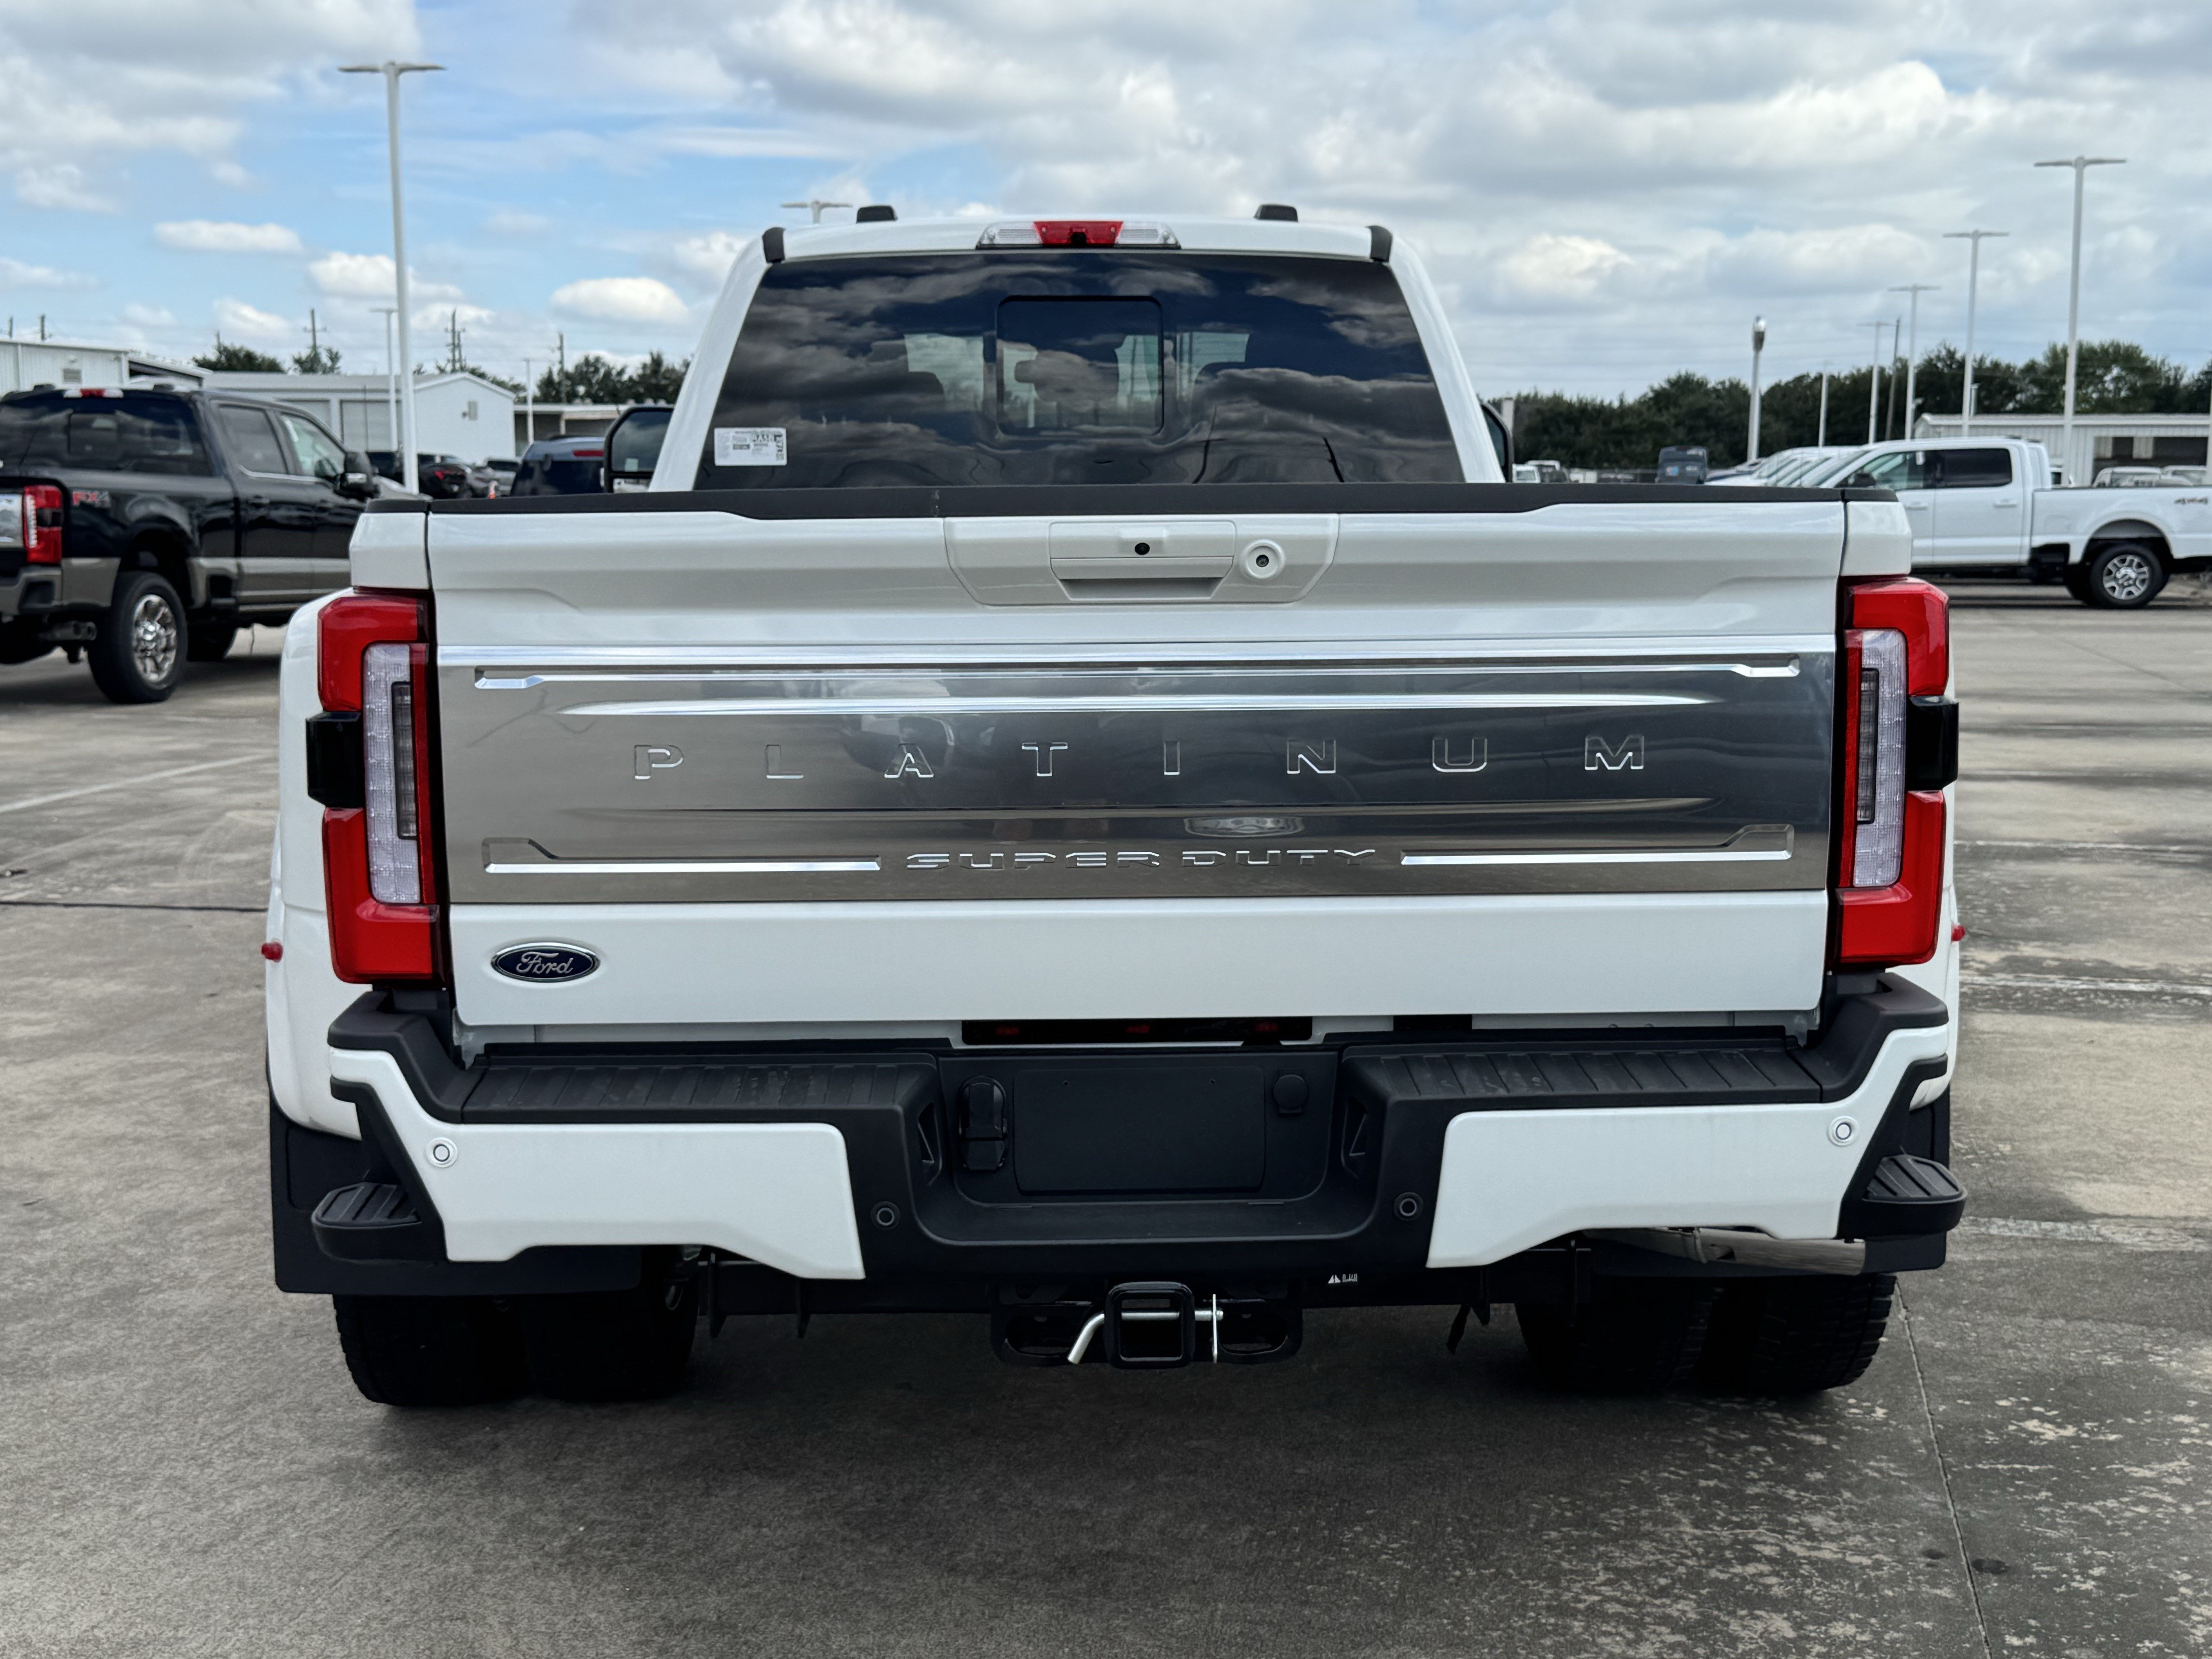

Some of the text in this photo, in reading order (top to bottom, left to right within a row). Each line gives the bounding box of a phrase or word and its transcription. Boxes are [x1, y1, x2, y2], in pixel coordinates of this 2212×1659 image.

[72, 490, 111, 508] FX4
[634, 735, 1645, 780] PLATINUM
[907, 849, 1376, 870] SUPER DUTY
[516, 951, 574, 974] Ford
